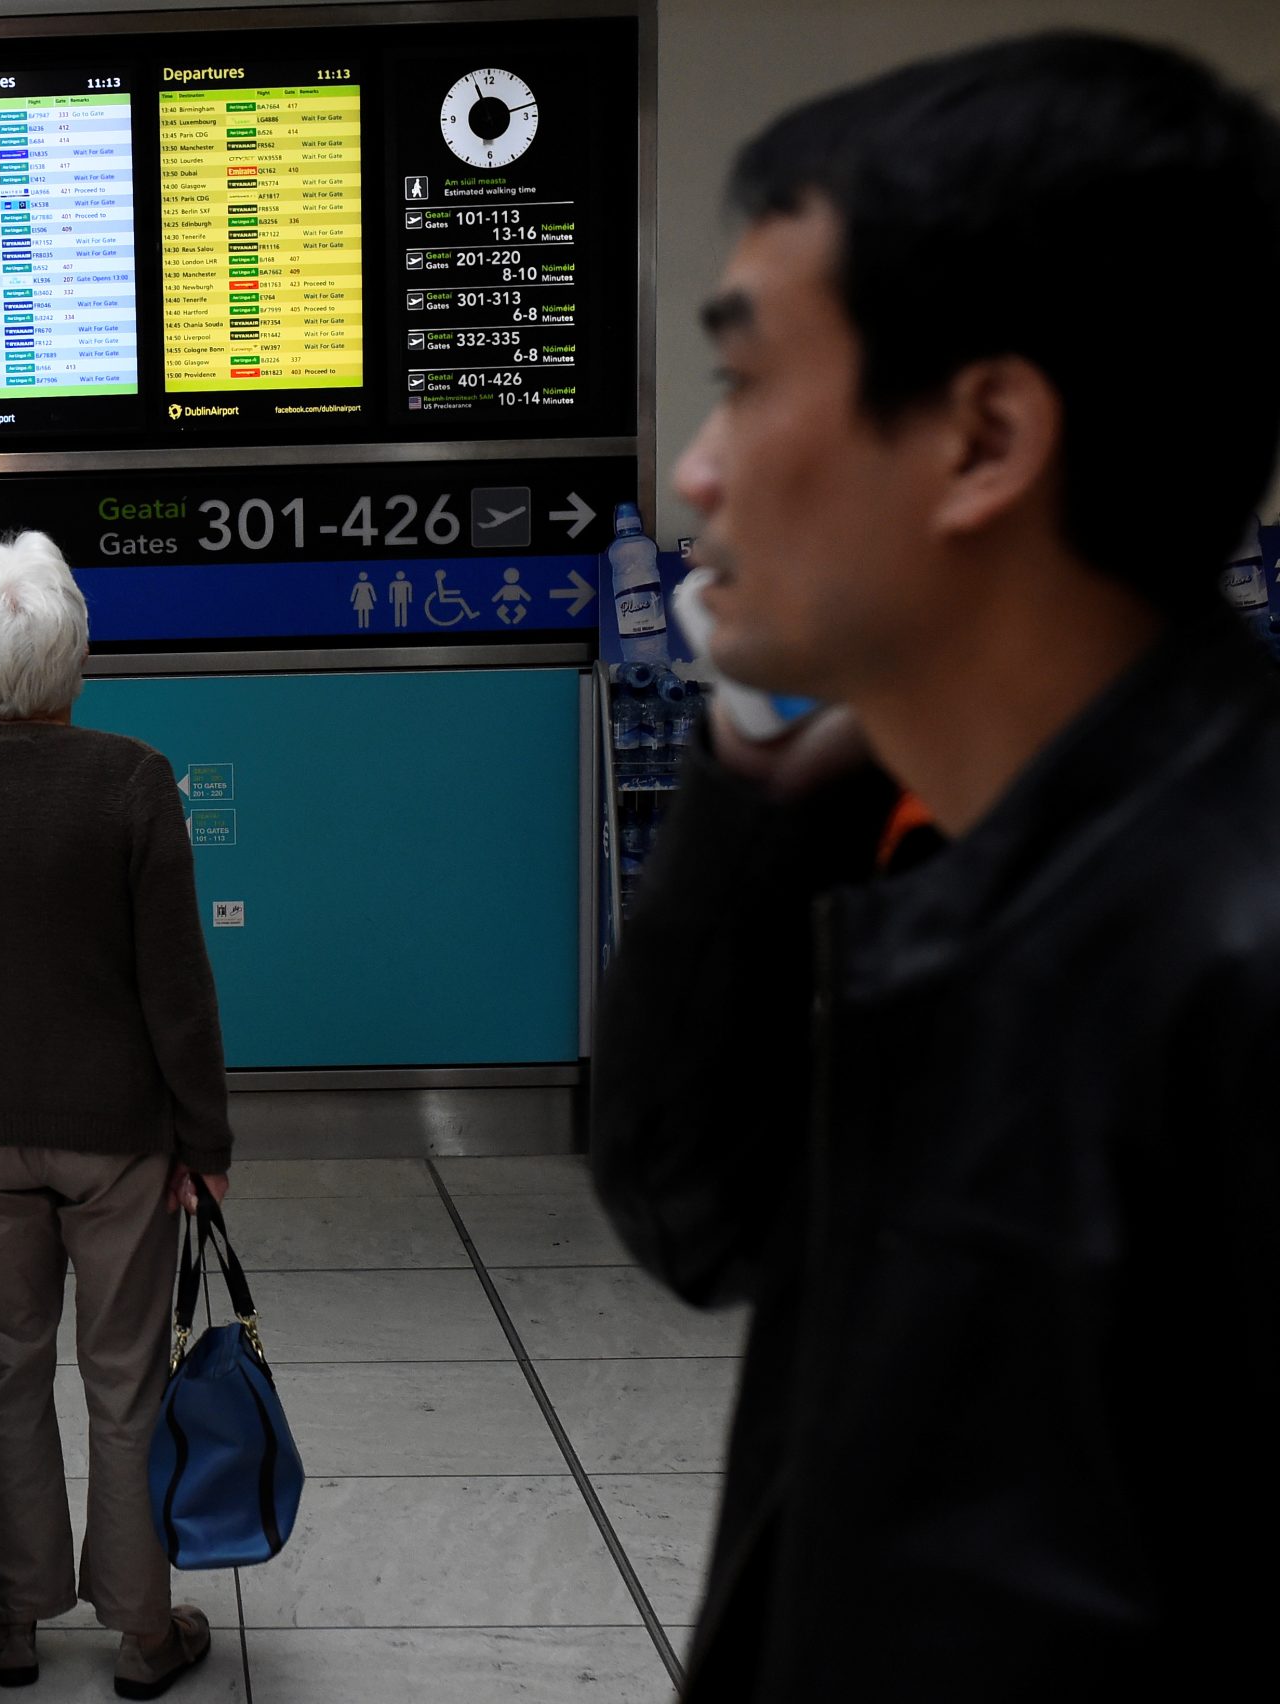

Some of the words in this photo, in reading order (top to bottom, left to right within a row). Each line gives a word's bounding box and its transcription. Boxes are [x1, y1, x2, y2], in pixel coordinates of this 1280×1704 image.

[163, 67, 244, 83] Departures
[317, 69, 351, 80] 11:13
[88, 78, 121, 88] 11:13
[484, 77, 494, 85] 12
[451, 116, 456, 124] 9
[523, 113, 529, 121] 3
[488, 151, 493, 159] 6
[445, 178, 458, 186] Am
[479, 177, 506, 185] measta
[445, 188, 483, 197] Estimated
[486, 187, 516, 195] walking
[519, 186, 536, 194] time
[425, 211, 451, 219] Geataí
[457, 210, 520, 226] 101-113
[425, 221, 448, 229] Gates
[541, 223, 575, 231] Nóiméid
[493, 227, 536, 241] 13-16
[541, 233, 573, 241] Minutes
[426, 252, 452, 260] Geataí
[457, 251, 521, 266] 201-220
[542, 264, 575, 272] Nóiméid
[503, 267, 537, 281] 8-10
[427, 292, 452, 300] Geataí
[457, 291, 521, 307] 301-313
[427, 302, 449, 310] Gates
[542, 304, 575, 312] Nóiméid
[513, 308, 537, 322] 6-8
[542, 314, 574, 322] Minutes
[427, 332, 453, 340] Geataí
[457, 332, 520, 347] 332-335
[428, 342, 450, 350] Gates
[543, 345, 576, 353] Nóiméid
[184, 347, 207, 355] Cologne
[514, 349, 538, 362] 6-8
[428, 373, 454, 381] Geataí
[458, 373, 522, 388] 401-426
[428, 383, 451, 391] Gates
[543, 387, 576, 395] Nóiméid
[185, 406, 239, 417] DublinAirport
[275, 404, 361, 414] facebook.com/dublinairport
[98, 496, 188, 521] Geataí
[198, 494, 460, 551] 301-426
[99, 531, 178, 557] Gates
